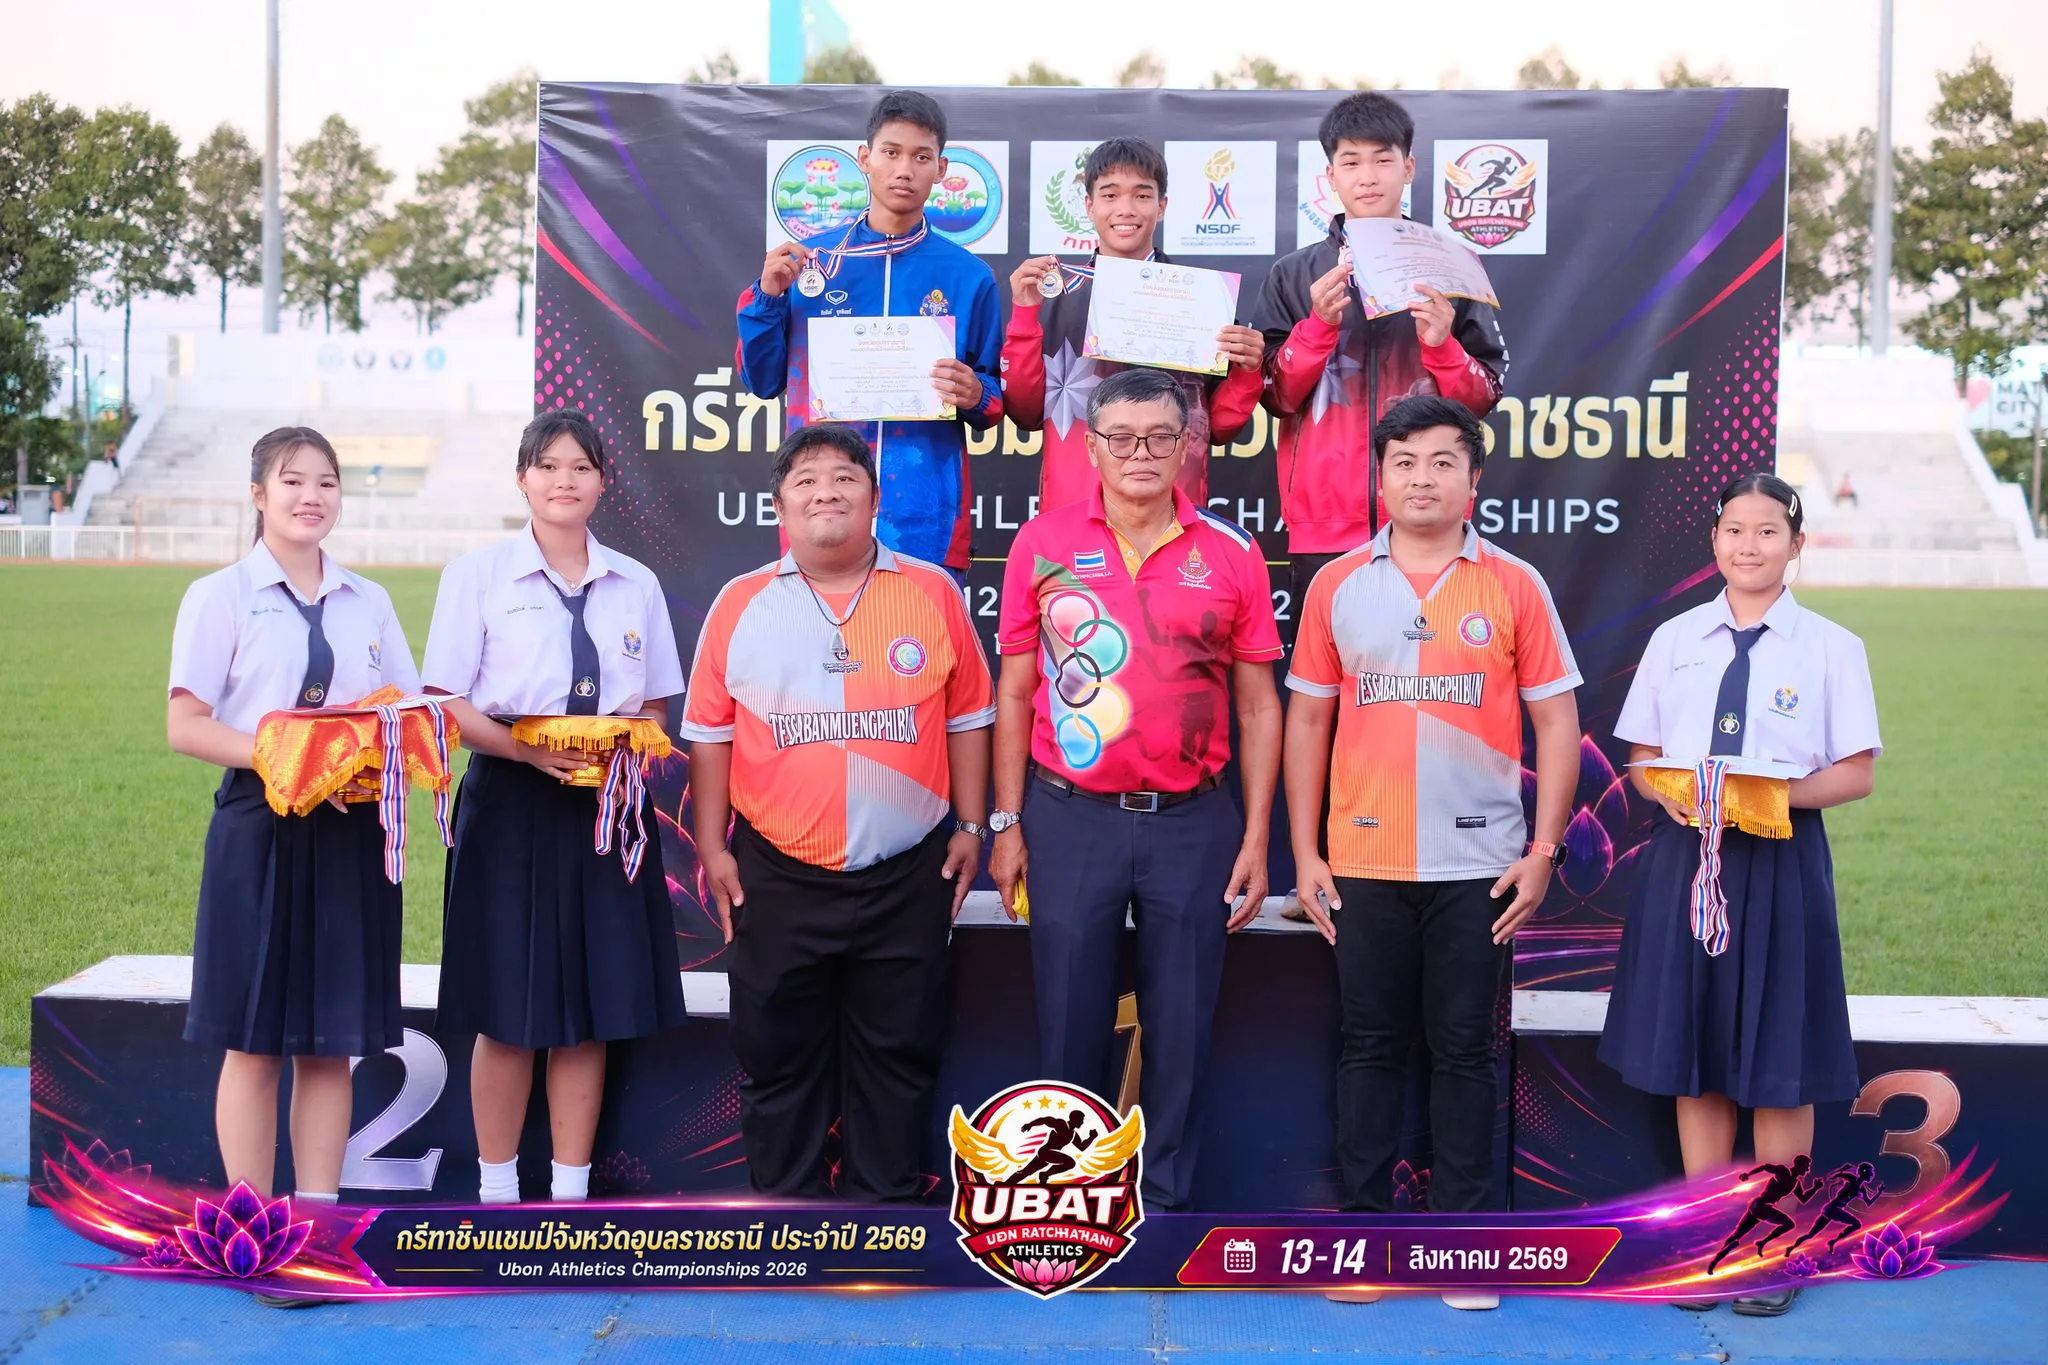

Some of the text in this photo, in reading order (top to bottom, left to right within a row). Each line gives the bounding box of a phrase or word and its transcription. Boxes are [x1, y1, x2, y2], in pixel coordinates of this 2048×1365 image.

[1451, 198, 1529, 218] UBAT
[1196, 224, 1240, 234] NSDF
[1063, 236, 1099, 250] กก
[1850, 1069, 1961, 1214] 3
